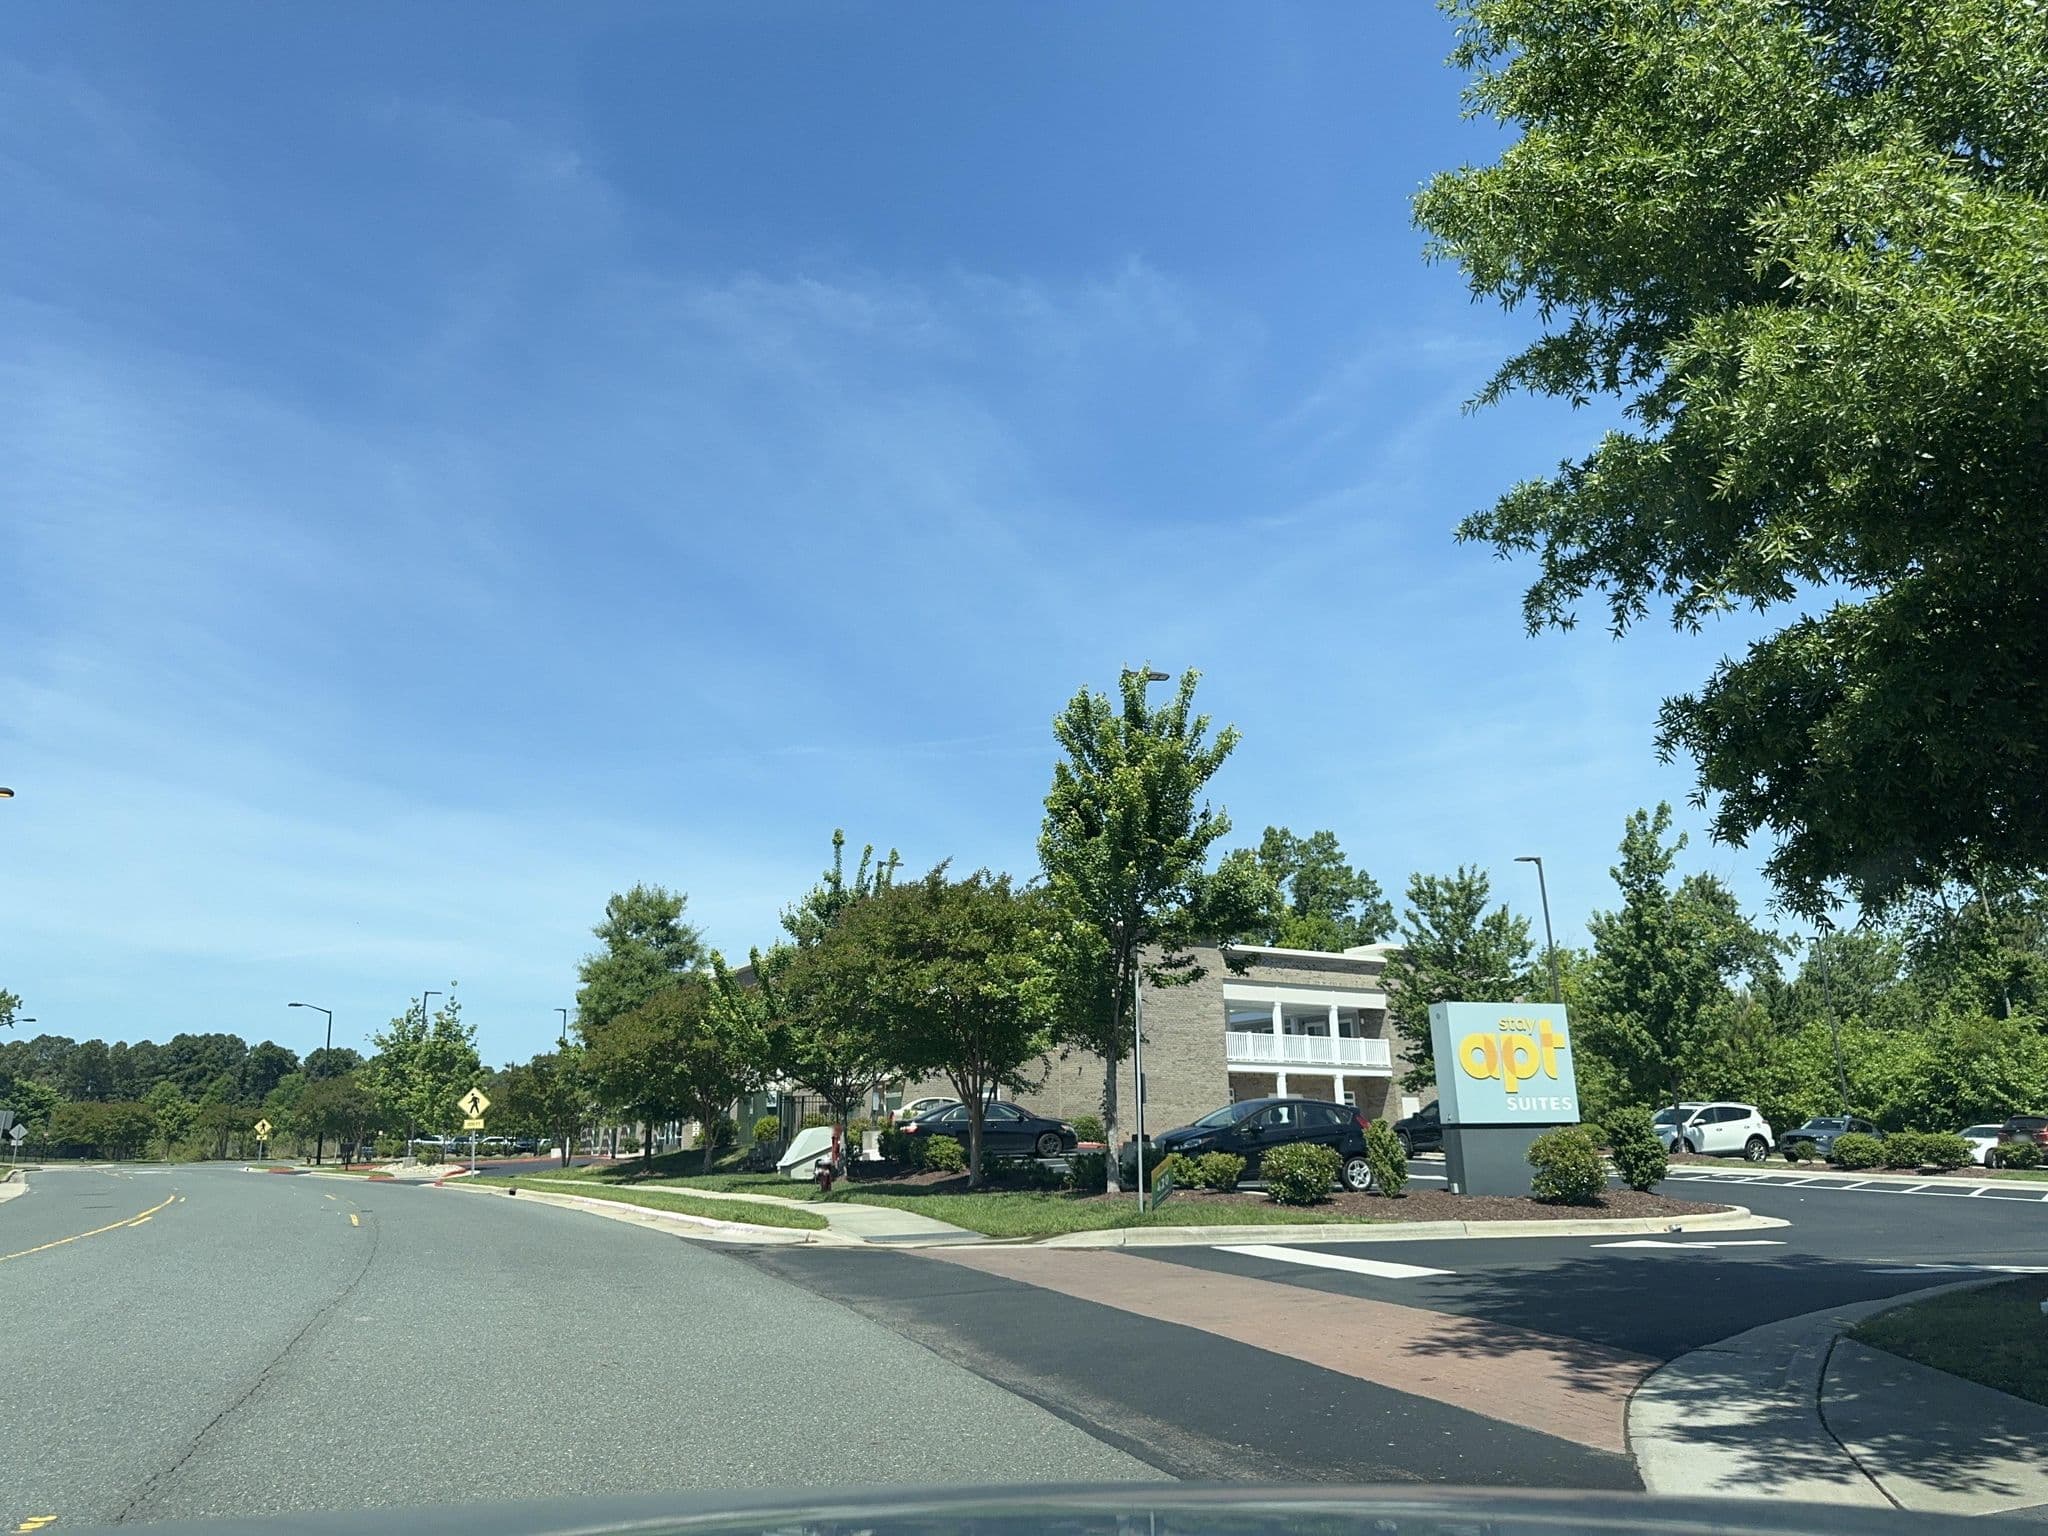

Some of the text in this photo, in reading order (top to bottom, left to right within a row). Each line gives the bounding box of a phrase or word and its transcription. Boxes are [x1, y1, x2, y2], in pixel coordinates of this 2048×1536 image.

[1499, 1016, 1536, 1036] stay
[1459, 1019, 1565, 1094] apt
[1506, 1096, 1573, 1111] SUITES
